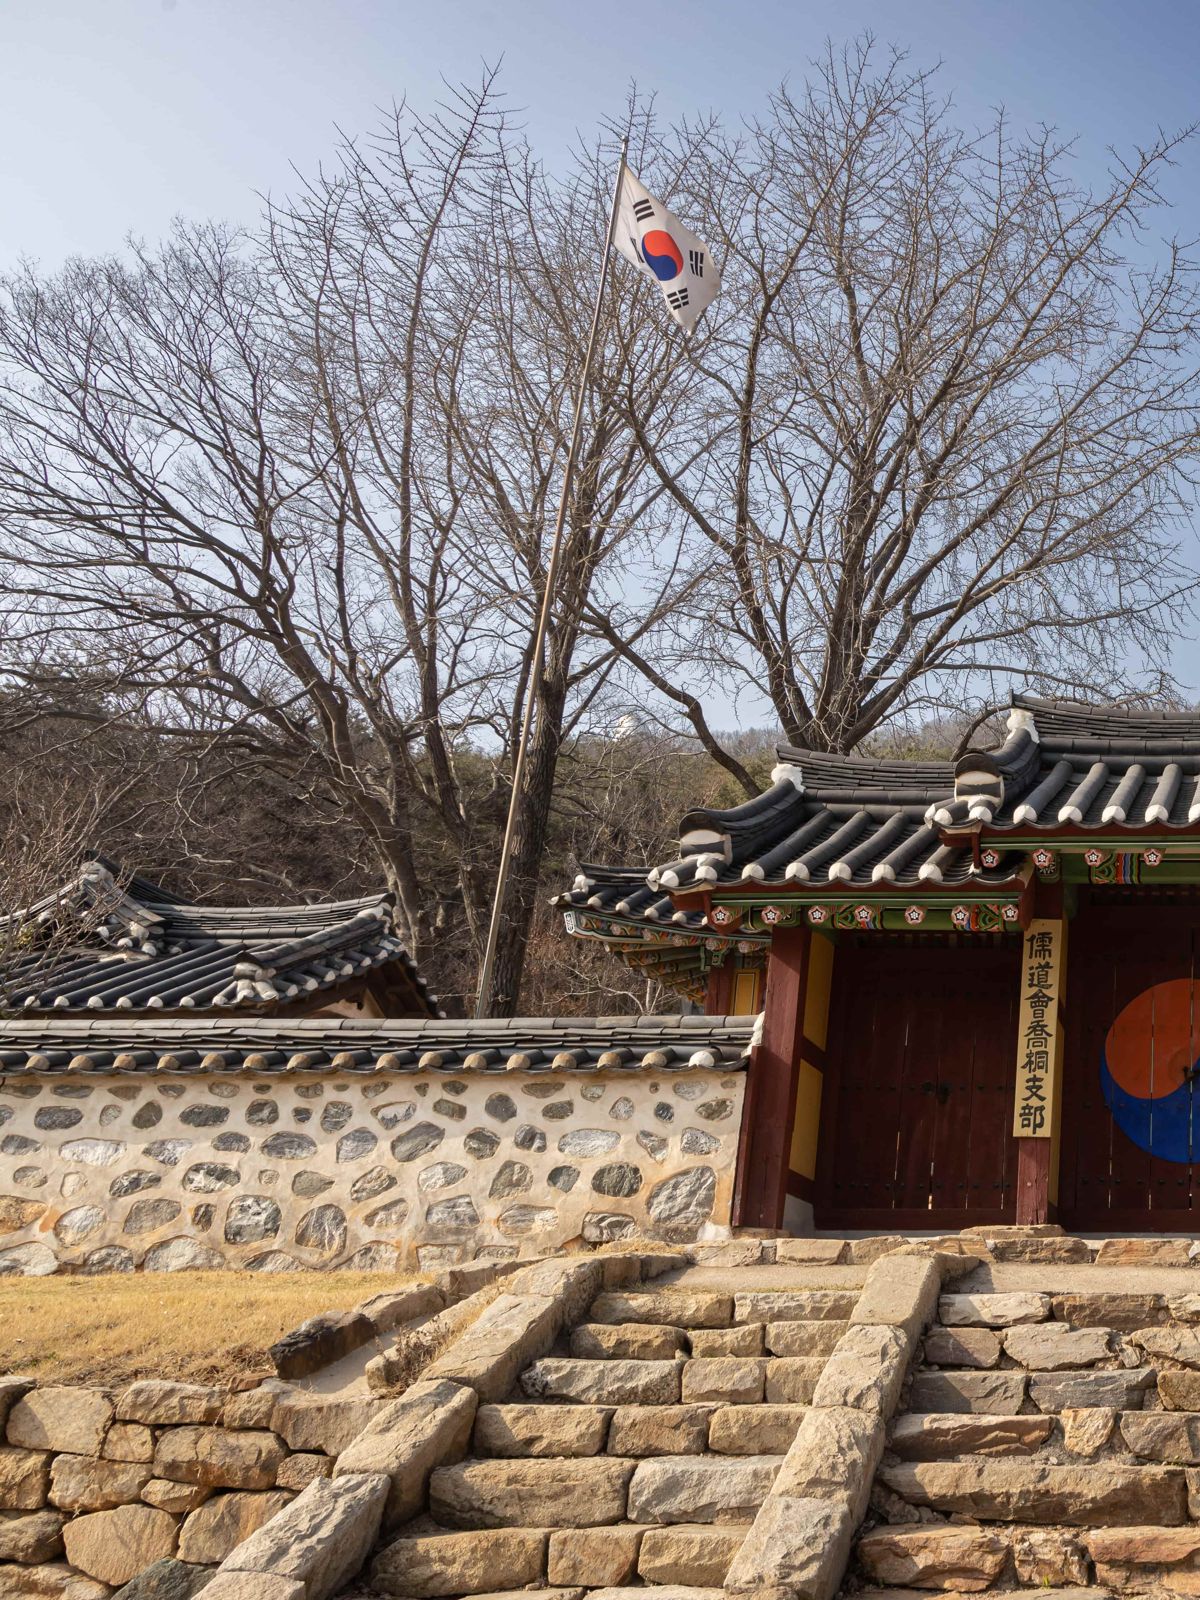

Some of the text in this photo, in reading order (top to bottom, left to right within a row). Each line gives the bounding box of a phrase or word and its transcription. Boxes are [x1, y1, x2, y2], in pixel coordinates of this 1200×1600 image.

[1019, 931, 1055, 1135] 儒道會喬桐支部
